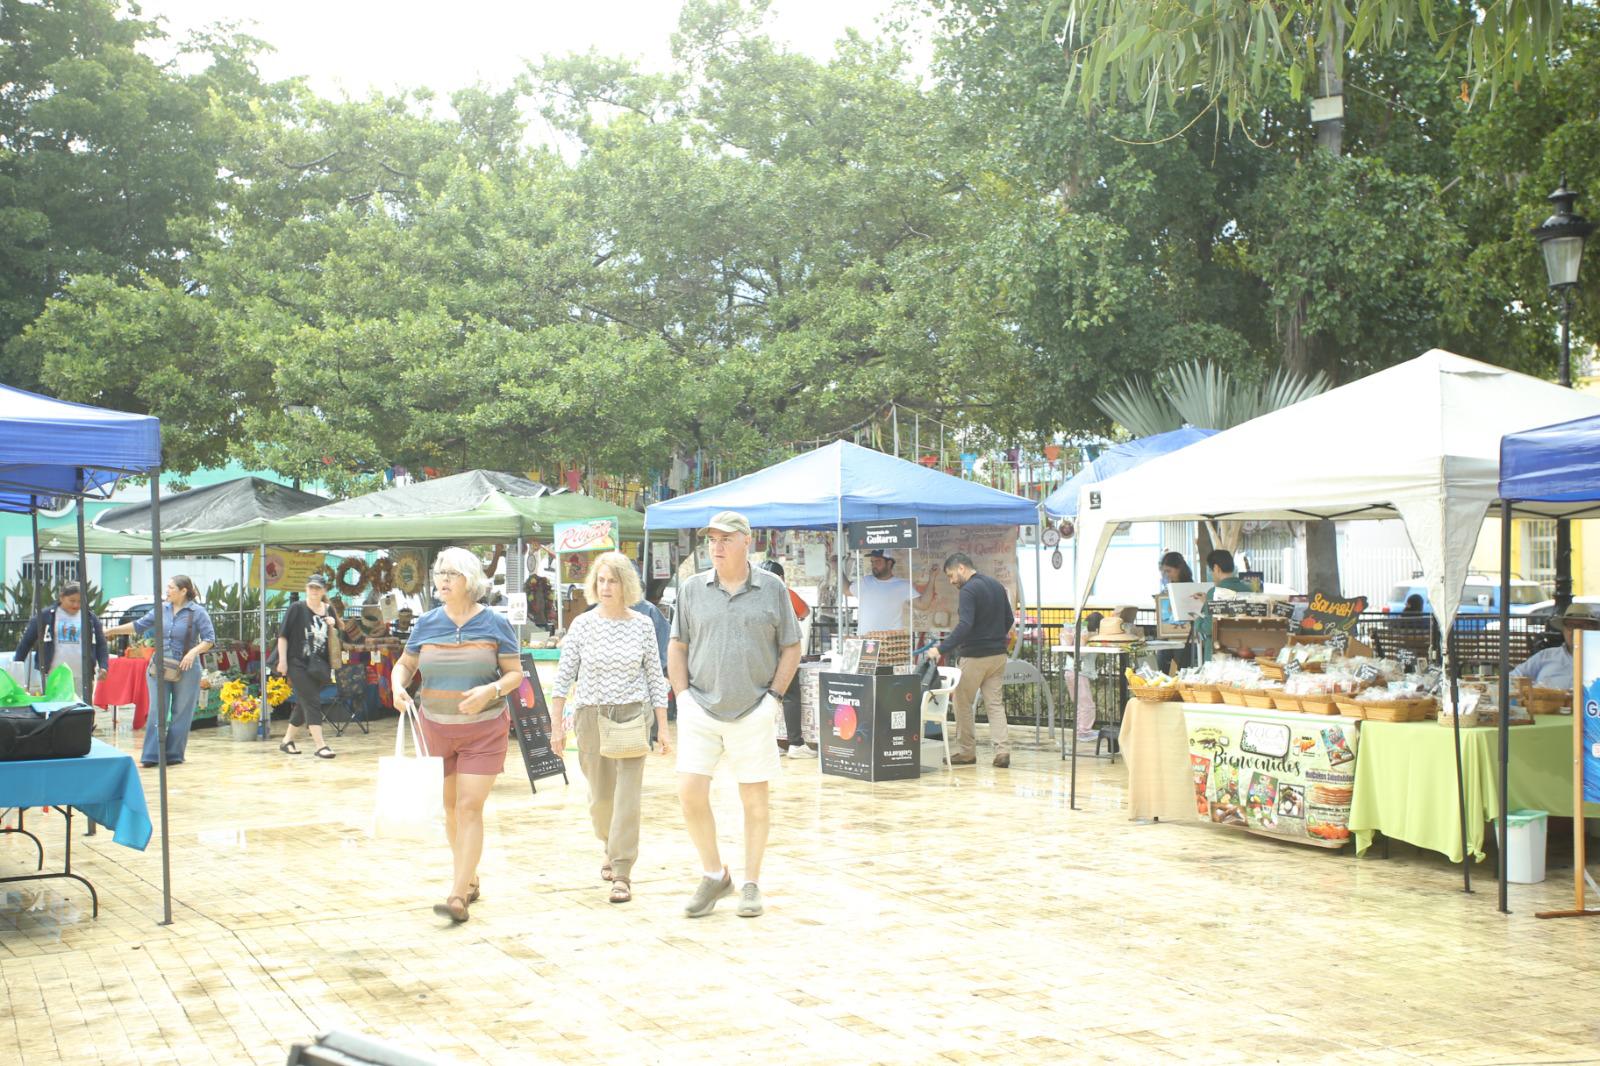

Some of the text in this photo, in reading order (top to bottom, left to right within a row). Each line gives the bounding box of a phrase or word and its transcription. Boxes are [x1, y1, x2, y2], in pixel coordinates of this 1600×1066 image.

[866, 534, 898, 544] Guitarra
[828, 694, 861, 707] Guitarra
[1214, 745, 1300, 776] Bienvenidos
